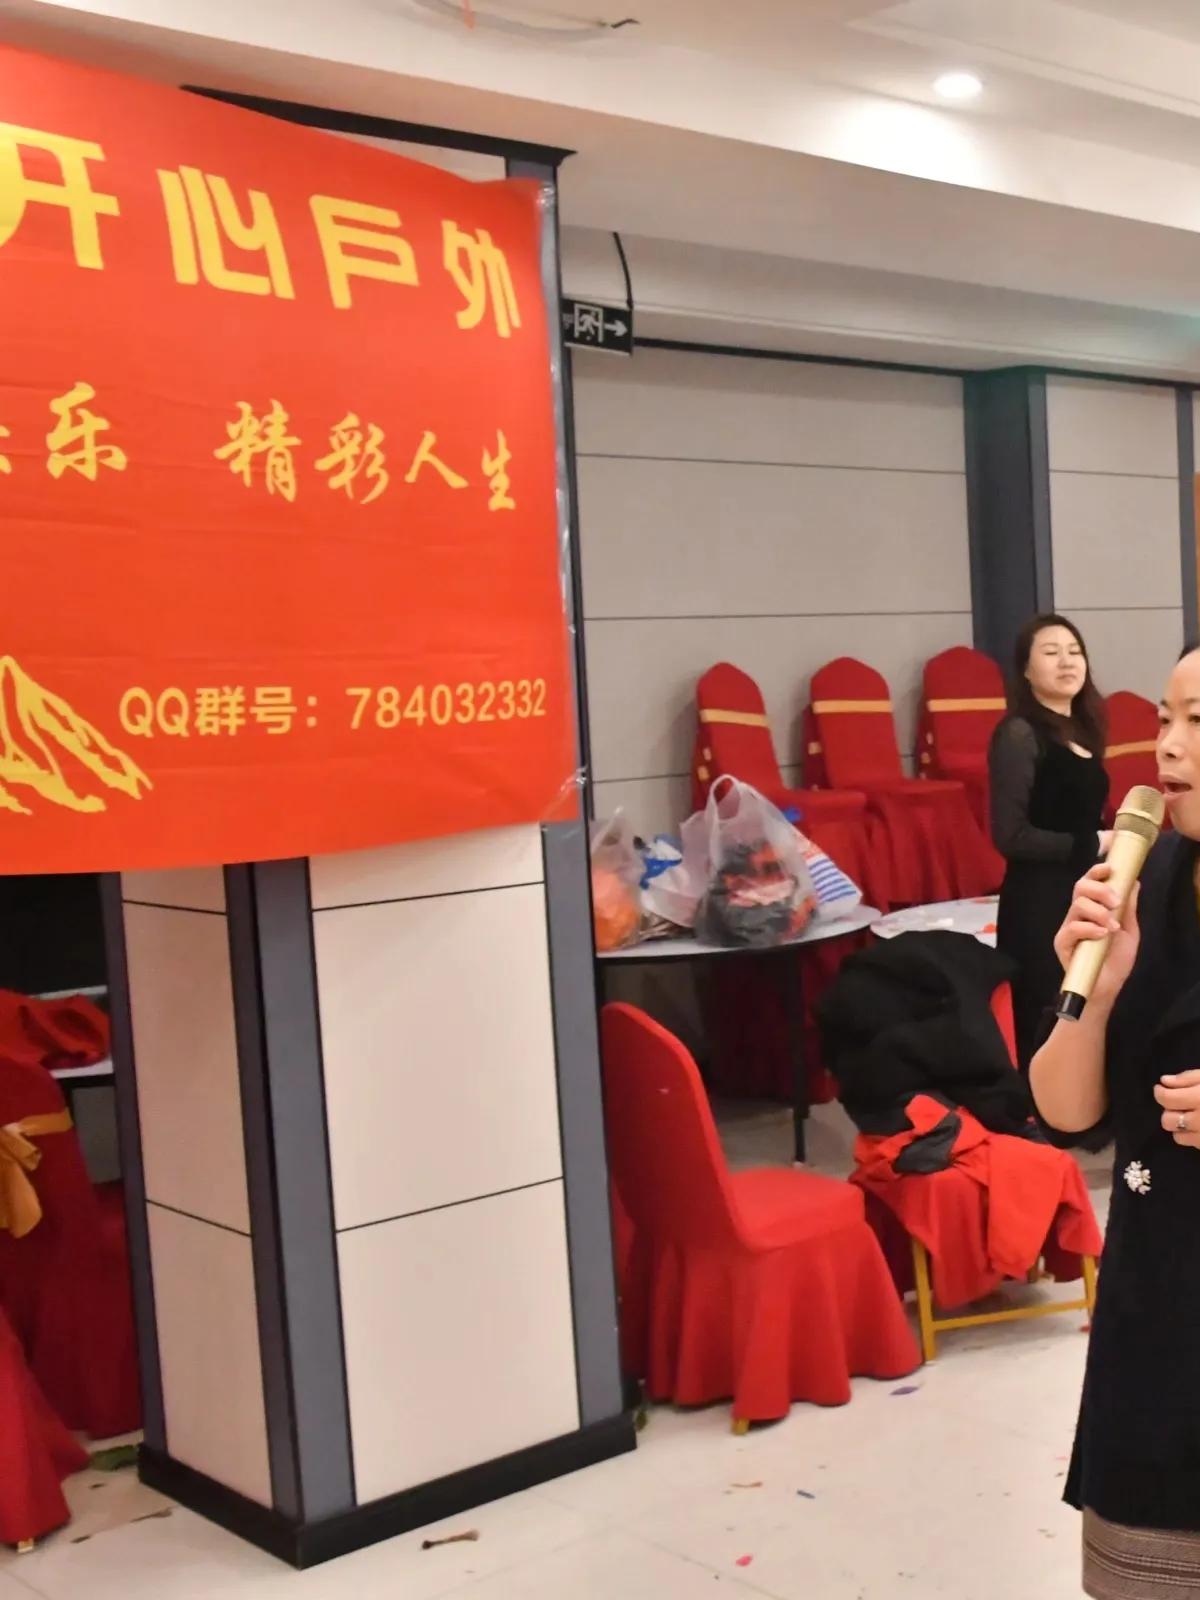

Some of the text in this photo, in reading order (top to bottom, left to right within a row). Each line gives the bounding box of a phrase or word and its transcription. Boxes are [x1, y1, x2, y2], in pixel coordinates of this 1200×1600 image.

[0, 382, 516, 511] 乐 精彩人生
